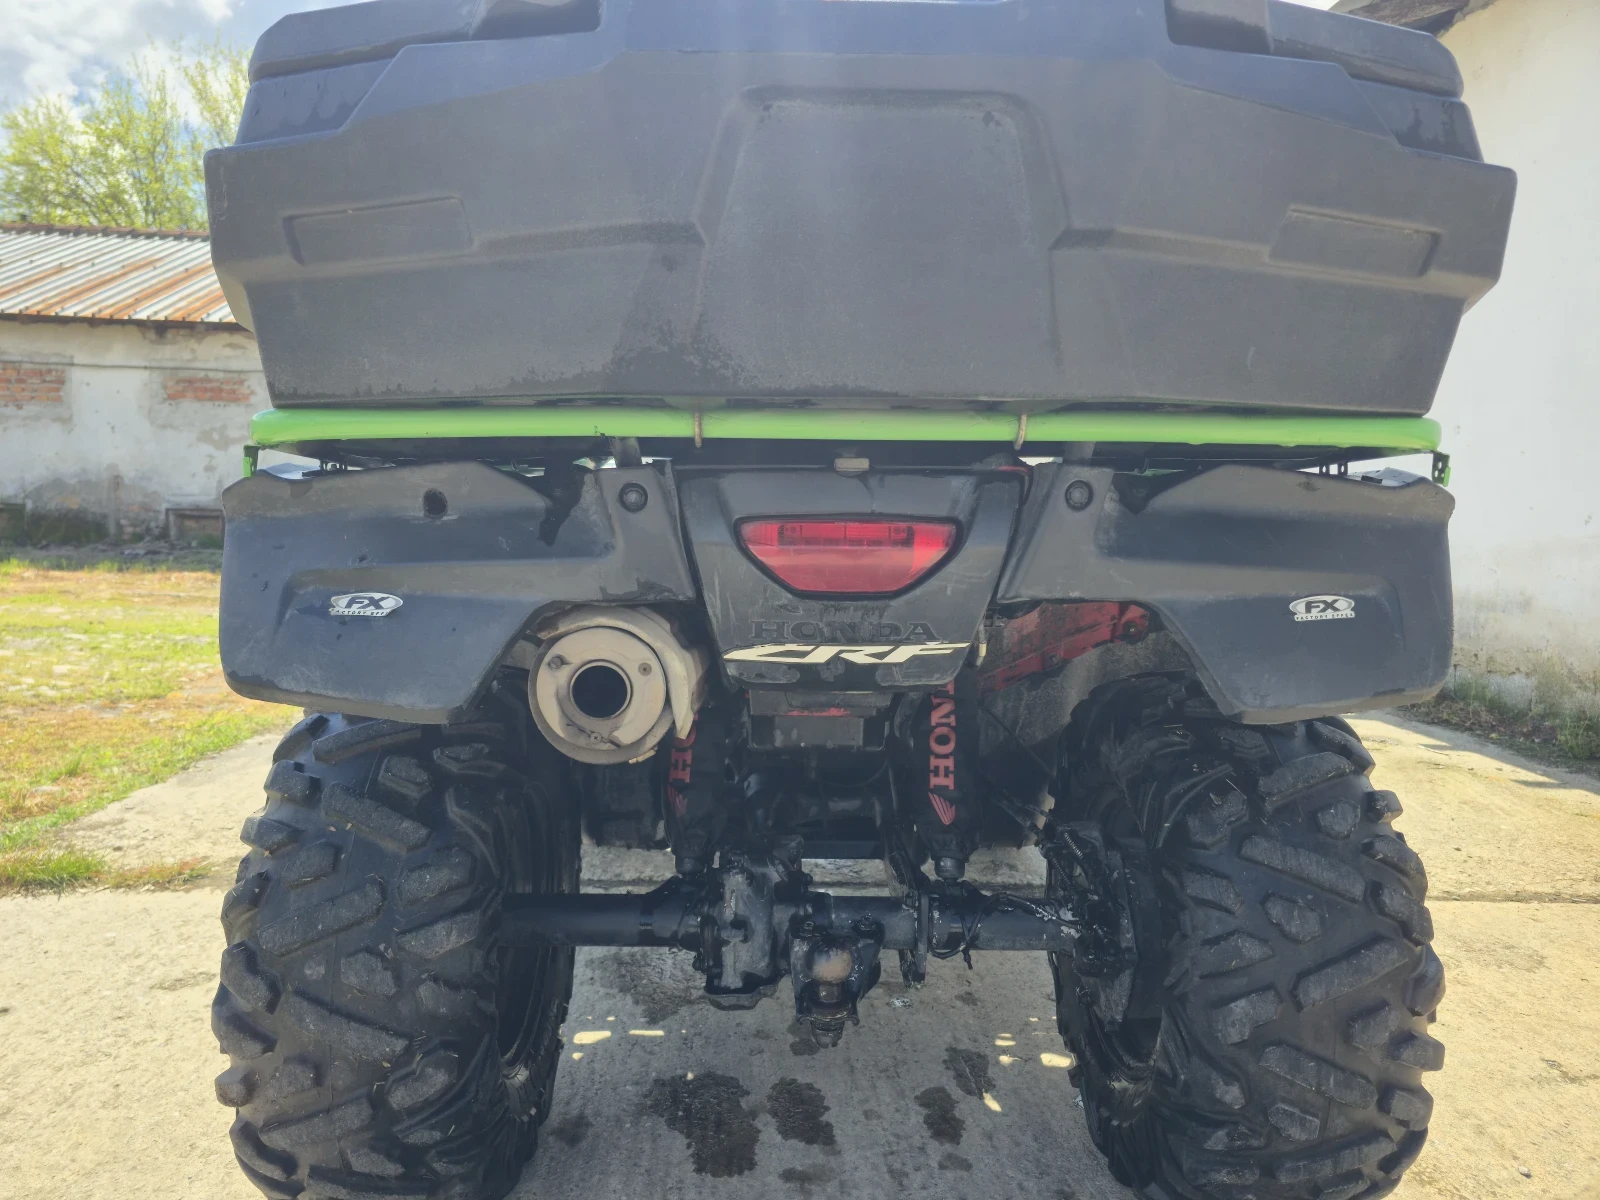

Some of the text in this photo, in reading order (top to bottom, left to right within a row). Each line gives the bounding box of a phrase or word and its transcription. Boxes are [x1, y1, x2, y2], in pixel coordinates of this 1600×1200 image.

[344, 596, 391, 610] FX
[1304, 599, 1341, 613] FX
[750, 620, 941, 642] HONDA
[723, 642, 971, 664] CRF
